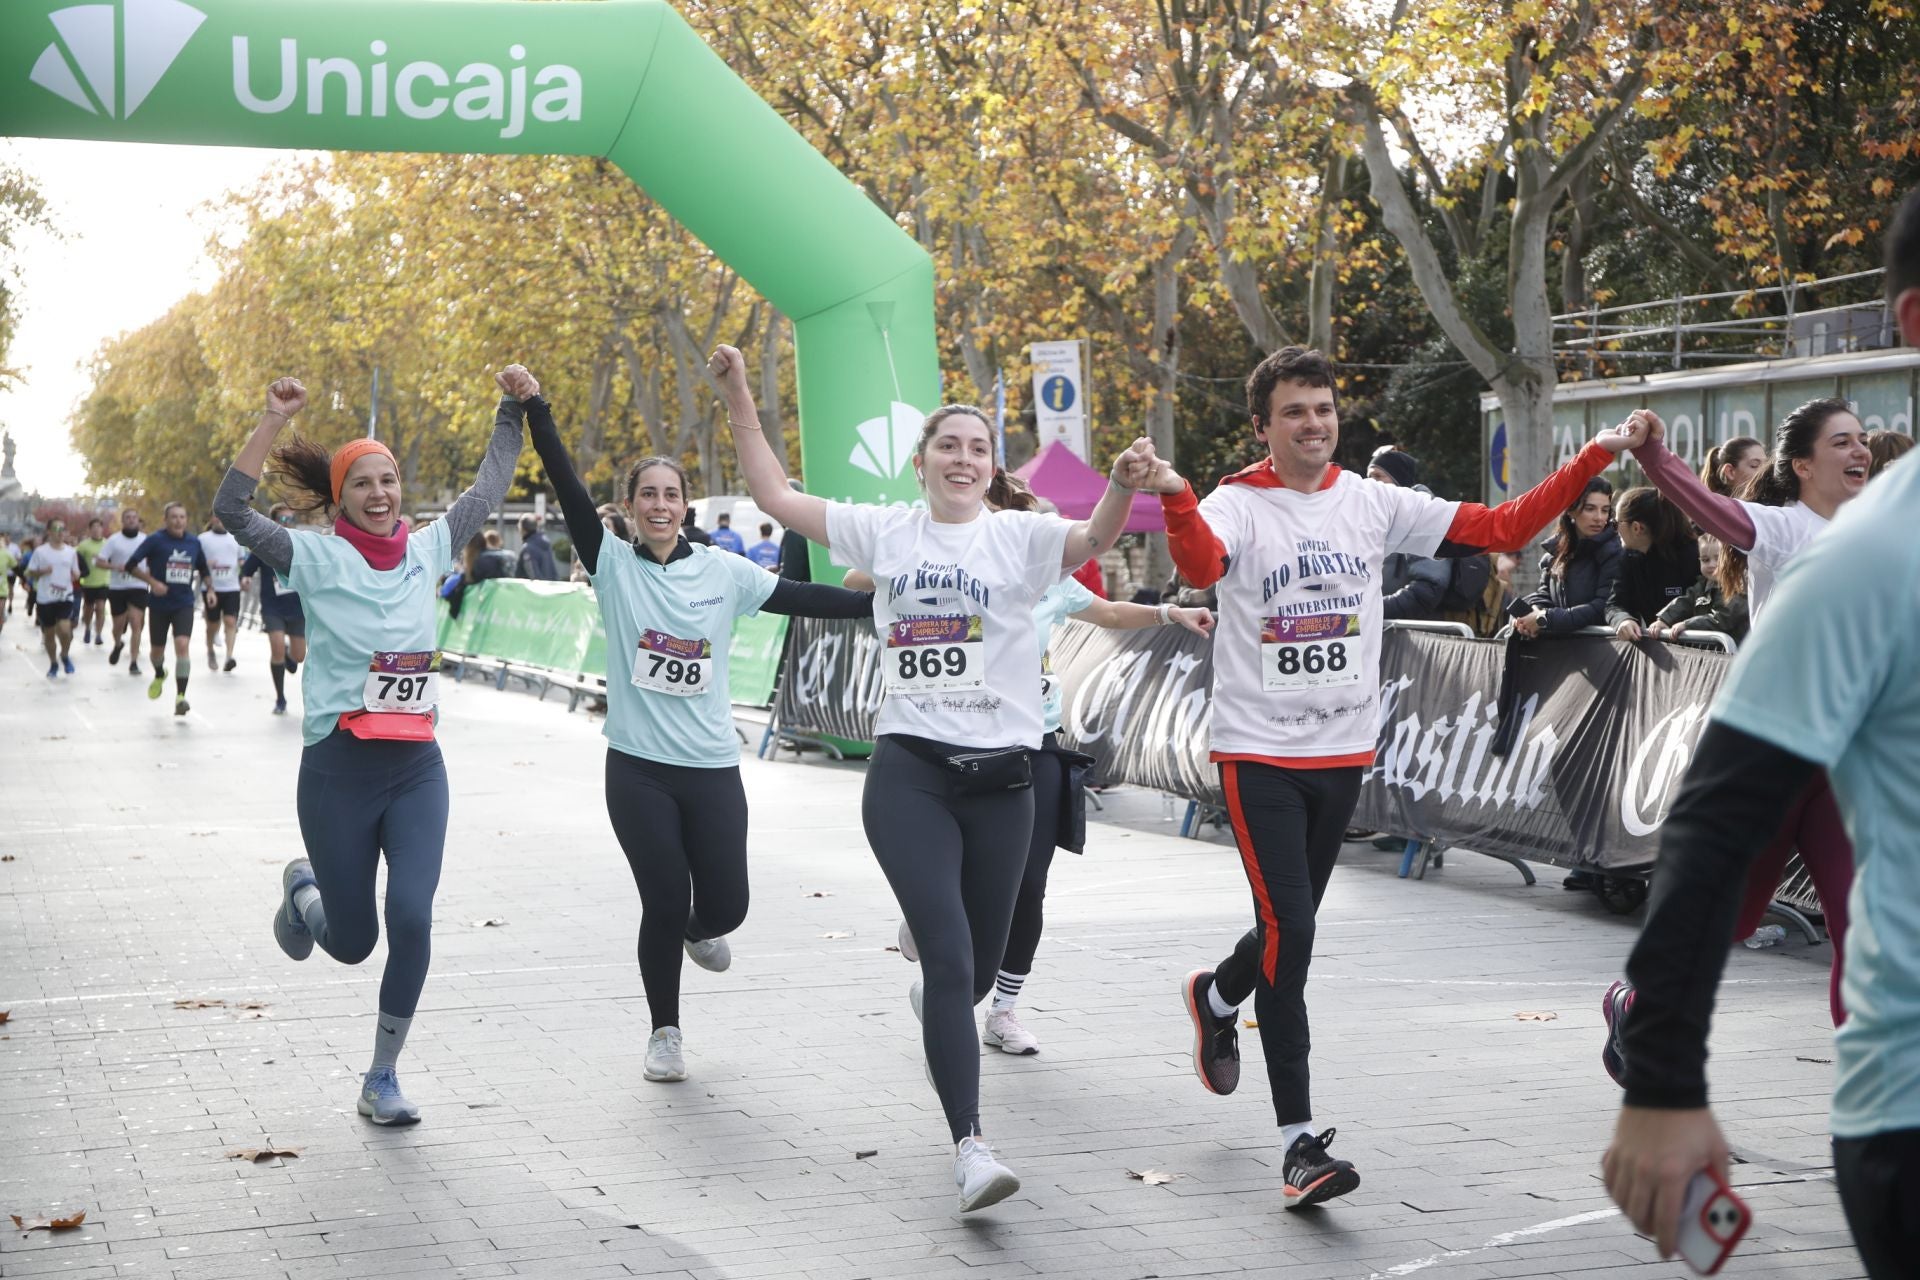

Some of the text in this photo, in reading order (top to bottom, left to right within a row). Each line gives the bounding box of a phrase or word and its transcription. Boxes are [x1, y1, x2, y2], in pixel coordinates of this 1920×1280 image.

[232, 35, 583, 138] Unicaja
[1263, 563, 1290, 604] RIO
[690, 595, 723, 608] OneHealth
[912, 627, 949, 636] EMPRESAS
[1296, 623, 1330, 633] EMPRESAS
[648, 653, 701, 685] 798
[899, 647, 967, 679] 869
[1277, 642, 1347, 675] 868
[377, 675, 428, 701] 797
